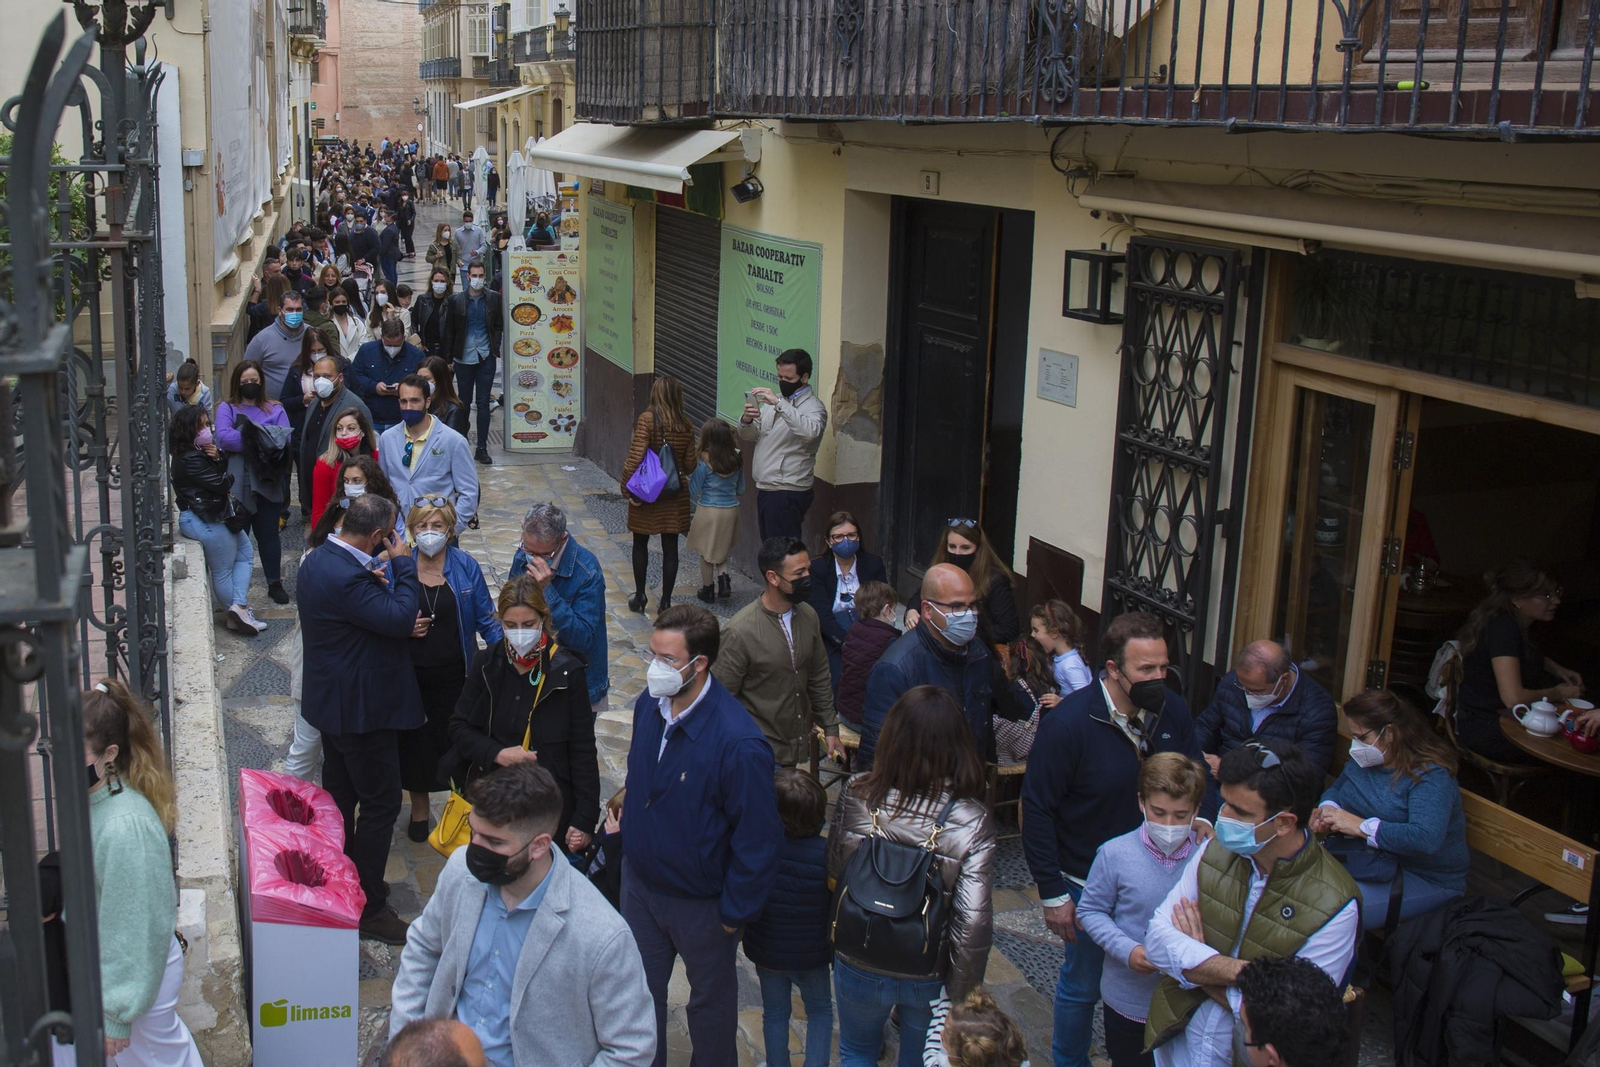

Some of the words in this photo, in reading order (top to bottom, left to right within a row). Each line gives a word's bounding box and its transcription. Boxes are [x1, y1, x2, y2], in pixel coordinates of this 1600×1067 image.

[926, 175, 930, 190] 9
[732, 239, 754, 256] BAZAR
[755, 246, 806, 268] COOPERATIV
[747, 264, 784, 284] TARIALTE
[290, 1004, 352, 1022] limasa
